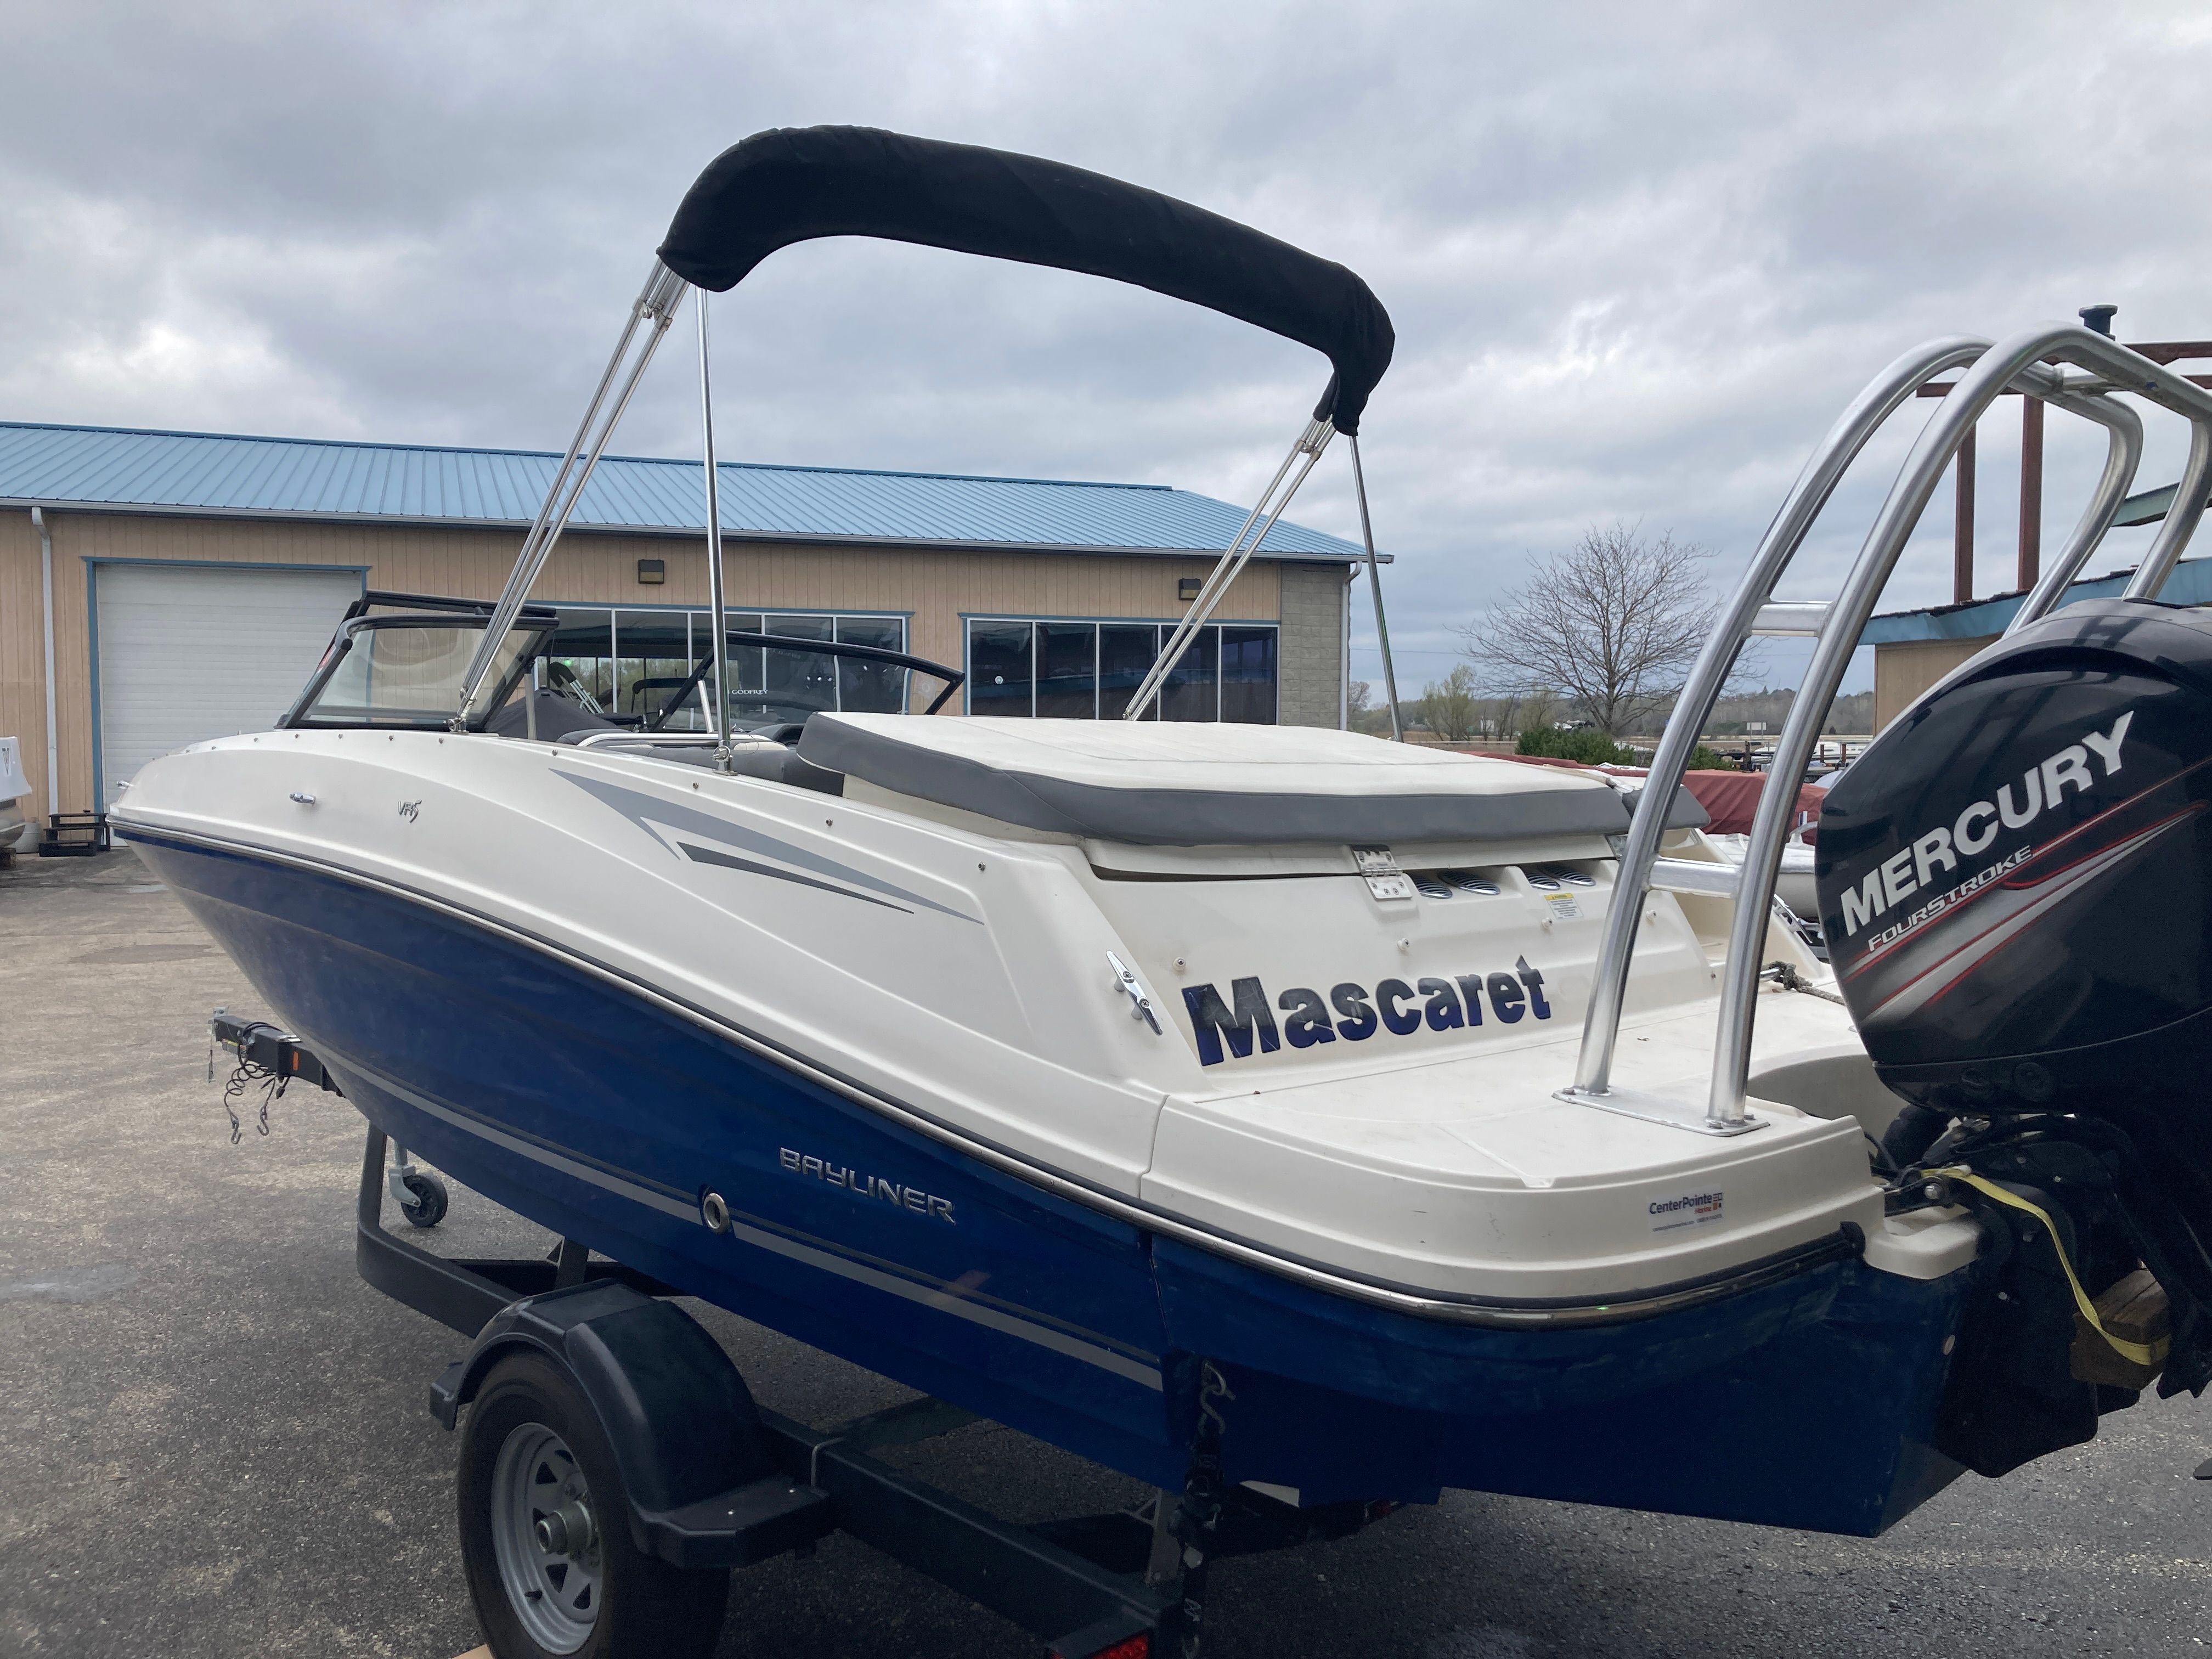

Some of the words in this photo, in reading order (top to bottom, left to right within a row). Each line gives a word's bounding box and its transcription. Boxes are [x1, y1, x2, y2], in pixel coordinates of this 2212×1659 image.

[1841, 710, 2134, 936] MERCURY
[1868, 845, 2033, 952] FOURSTROKE
[1182, 955, 1551, 1066] Mascaret
[780, 1147, 956, 1226] BAYLINER
[1649, 1194, 1712, 1214] CenterPointe
